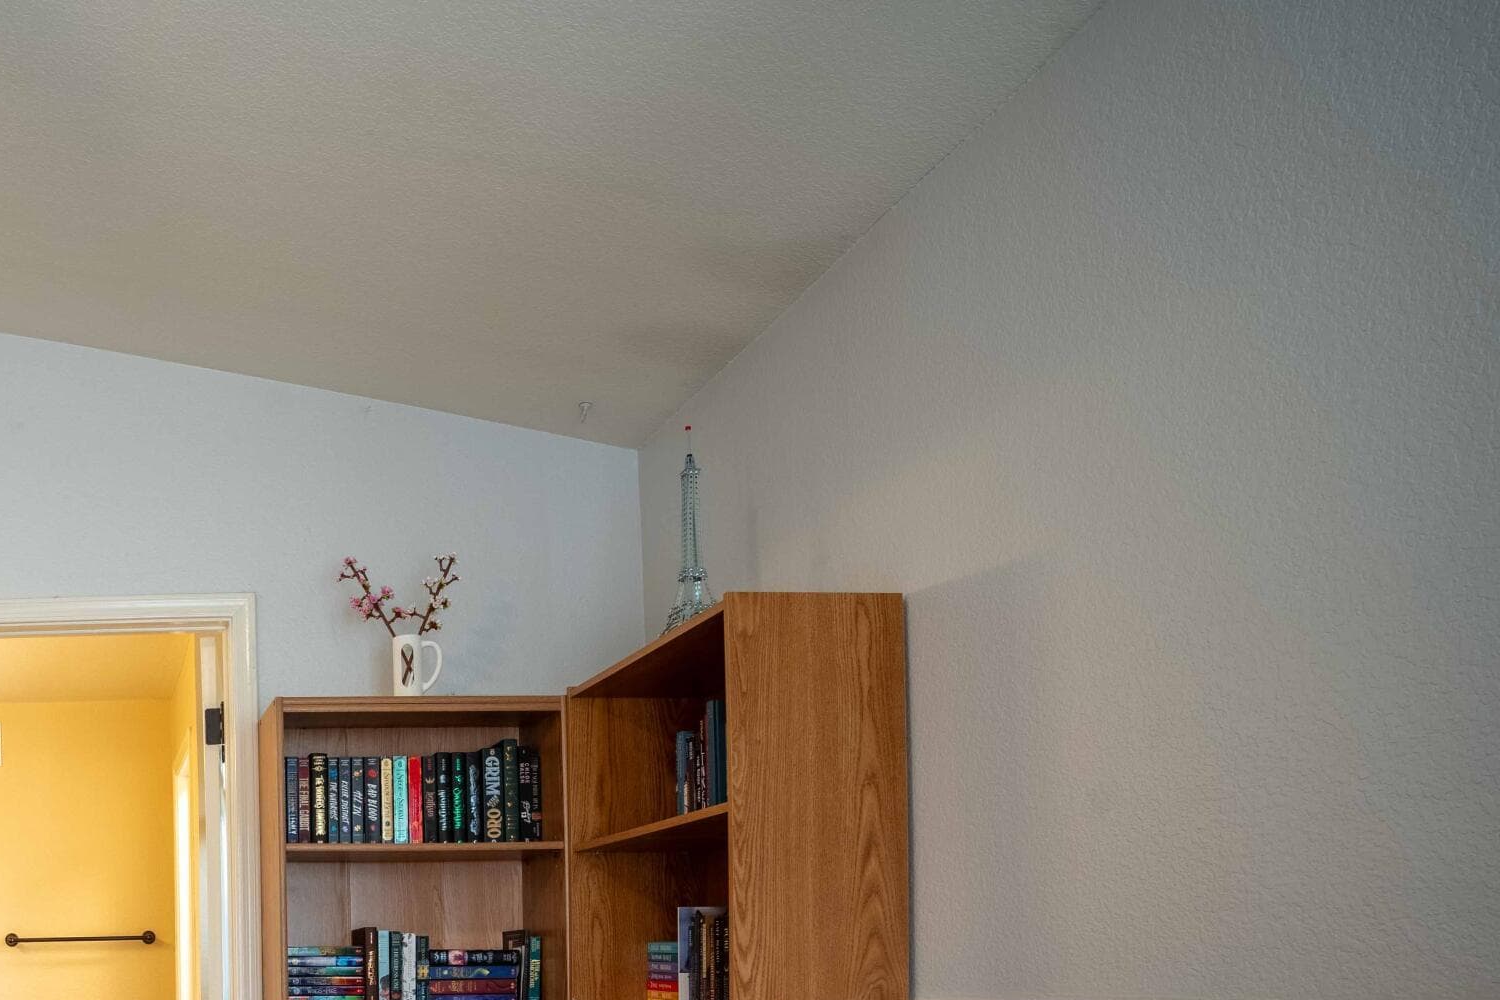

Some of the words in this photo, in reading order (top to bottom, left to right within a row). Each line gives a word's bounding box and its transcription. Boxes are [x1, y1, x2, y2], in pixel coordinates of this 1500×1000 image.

[484, 755, 501, 796] GRIM
[299, 790, 309, 808] FINAL
[367, 783, 378, 798] BAD
[299, 809, 310, 831] GAMBIT
[352, 804, 362, 817] IN
[367, 799, 377, 822] BLOOD
[486, 808, 502, 838] ORO
